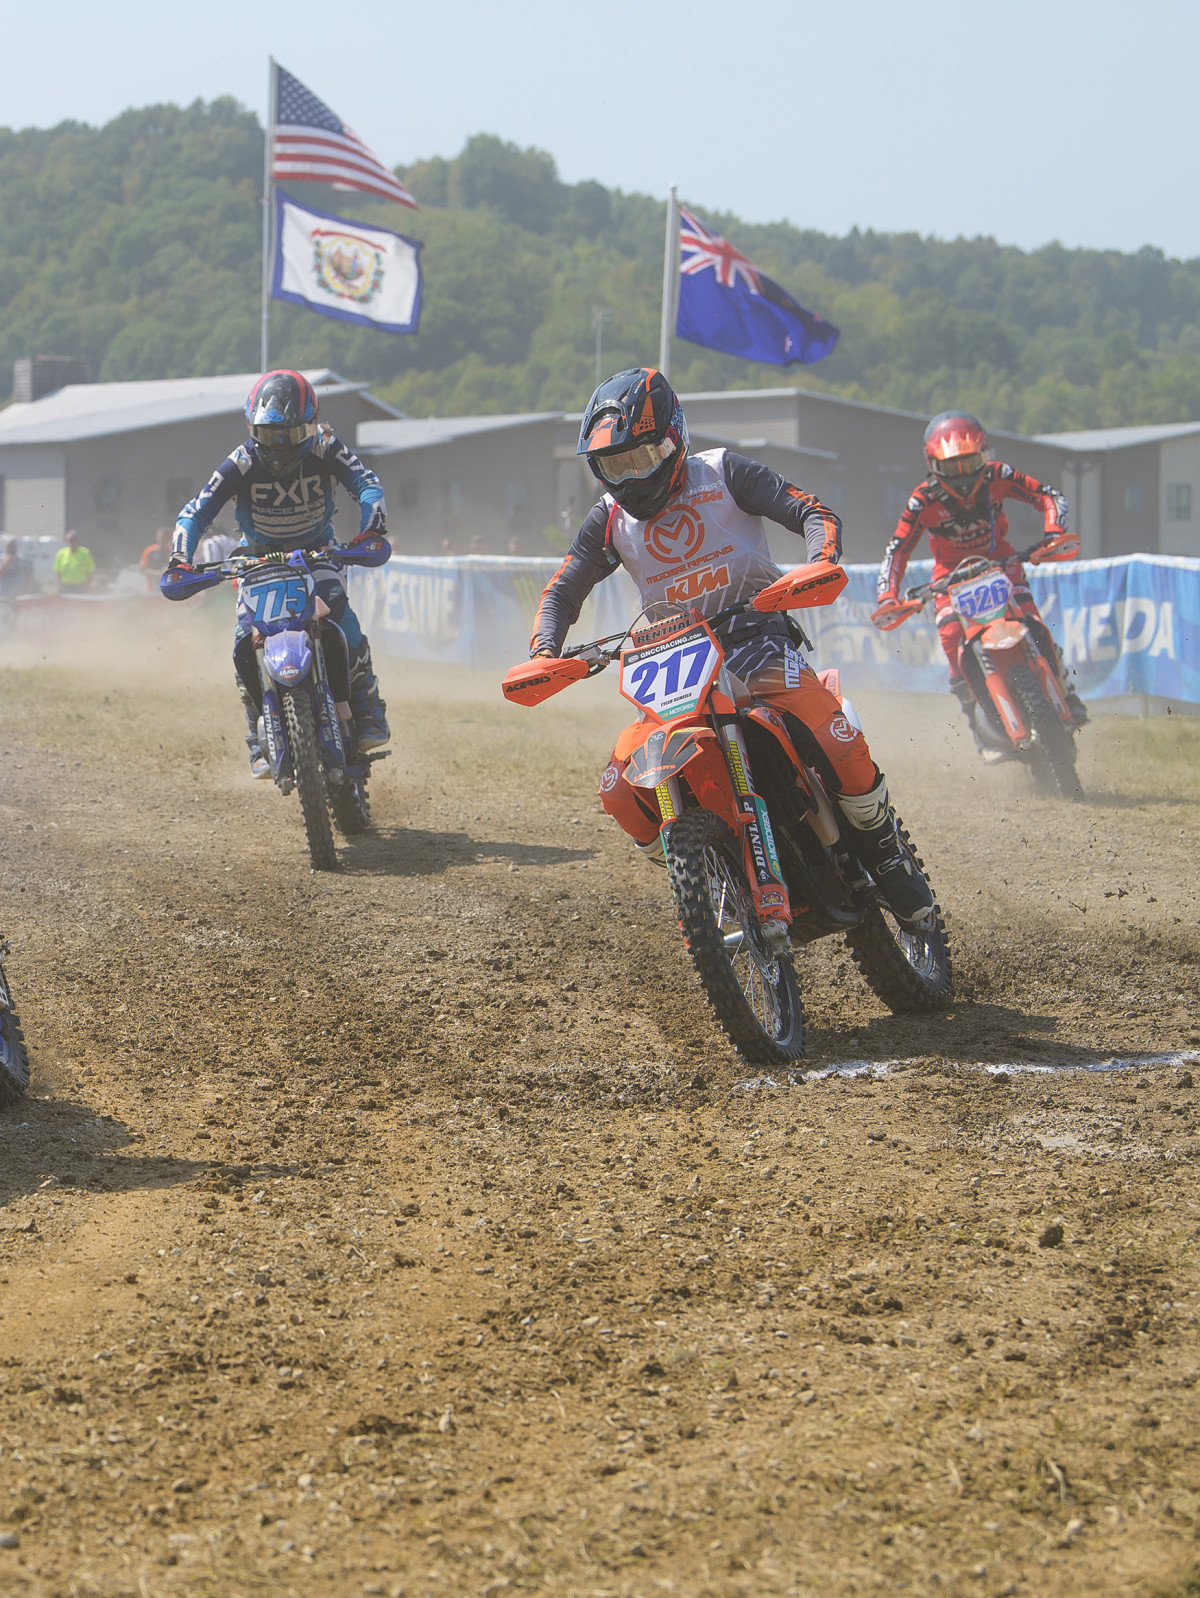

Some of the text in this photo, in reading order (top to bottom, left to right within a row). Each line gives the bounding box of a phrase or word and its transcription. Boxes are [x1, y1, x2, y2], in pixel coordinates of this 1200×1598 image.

[251, 473, 324, 506] FXR
[690, 490, 724, 508] KTM
[645, 544, 734, 585] MOOSE RACING
[665, 563, 731, 607] KTM
[791, 572, 842, 596] ACERBIS
[251, 578, 307, 622] 775
[957, 579, 1009, 619] 526
[636, 617, 694, 645] RENTHAL
[505, 676, 551, 693] ACERBIS
[630, 640, 712, 706] 217
[263, 704, 277, 761] DUNLOP
[326, 694, 343, 751] DUNLOP
[744, 801, 766, 869] DUNLP
